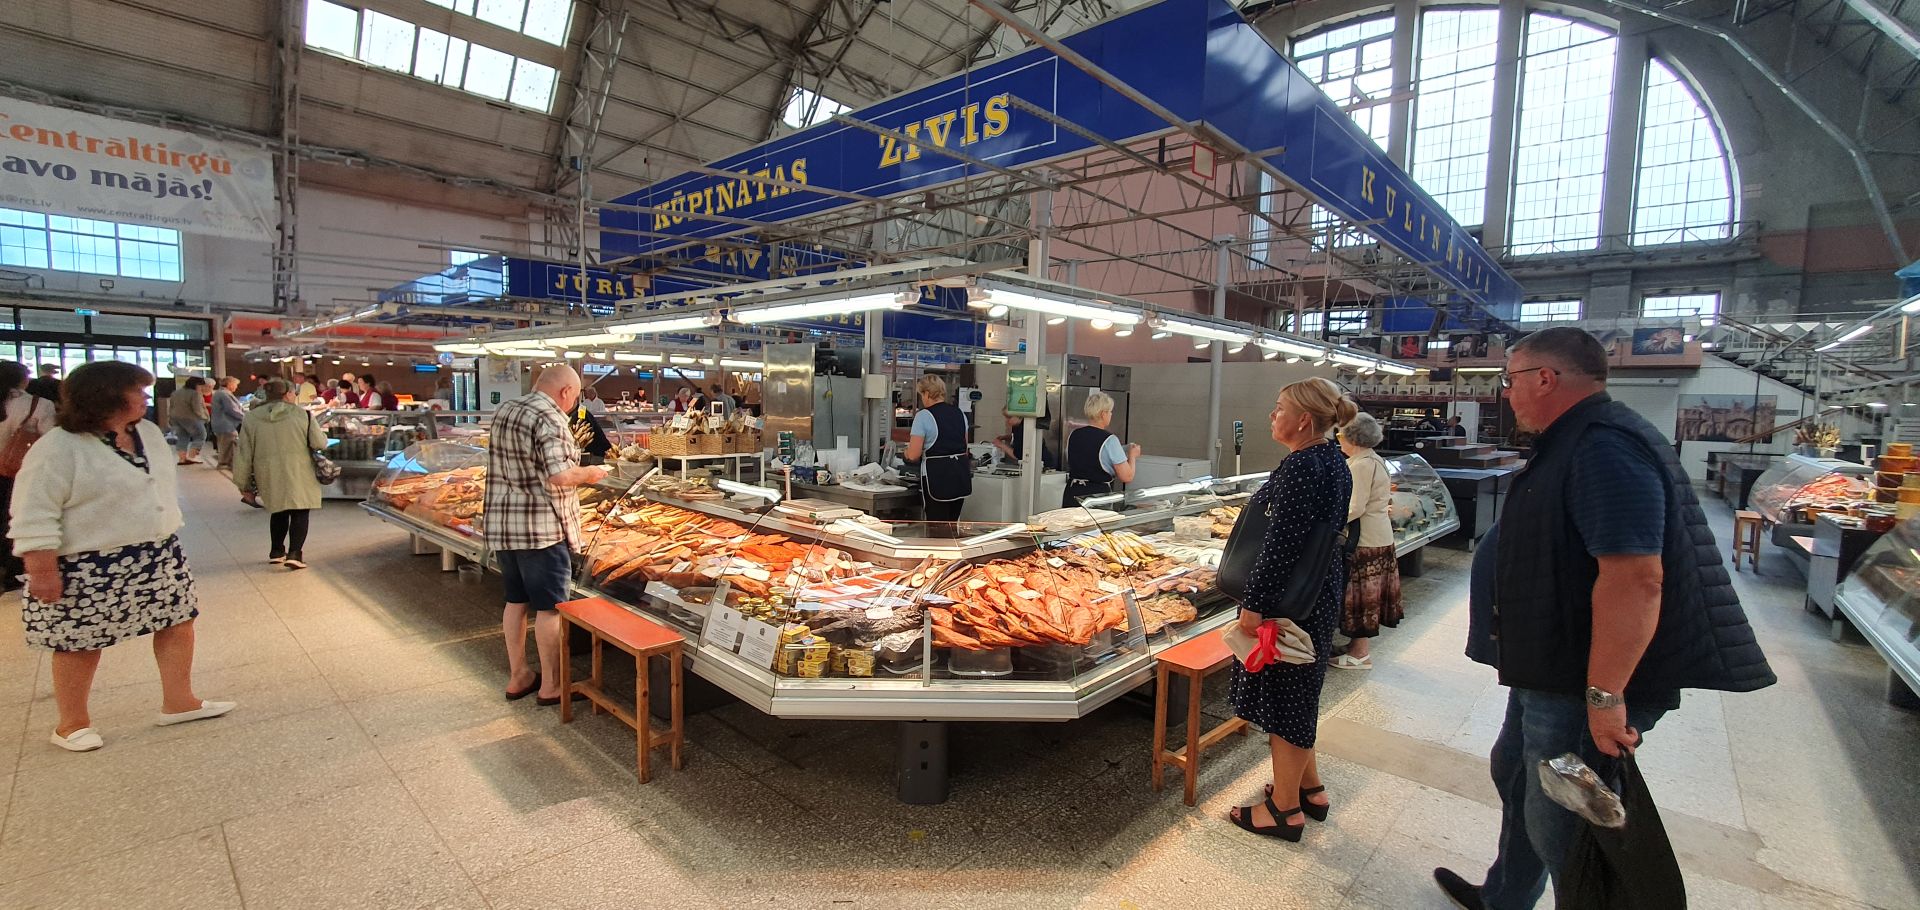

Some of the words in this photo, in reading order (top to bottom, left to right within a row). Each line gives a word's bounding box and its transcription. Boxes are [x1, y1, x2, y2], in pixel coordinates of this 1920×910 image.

[90, 168, 213, 201] mājās!
[652, 157, 808, 231] KŪPINĀTAS
[878, 91, 1010, 169] ZIVIS
